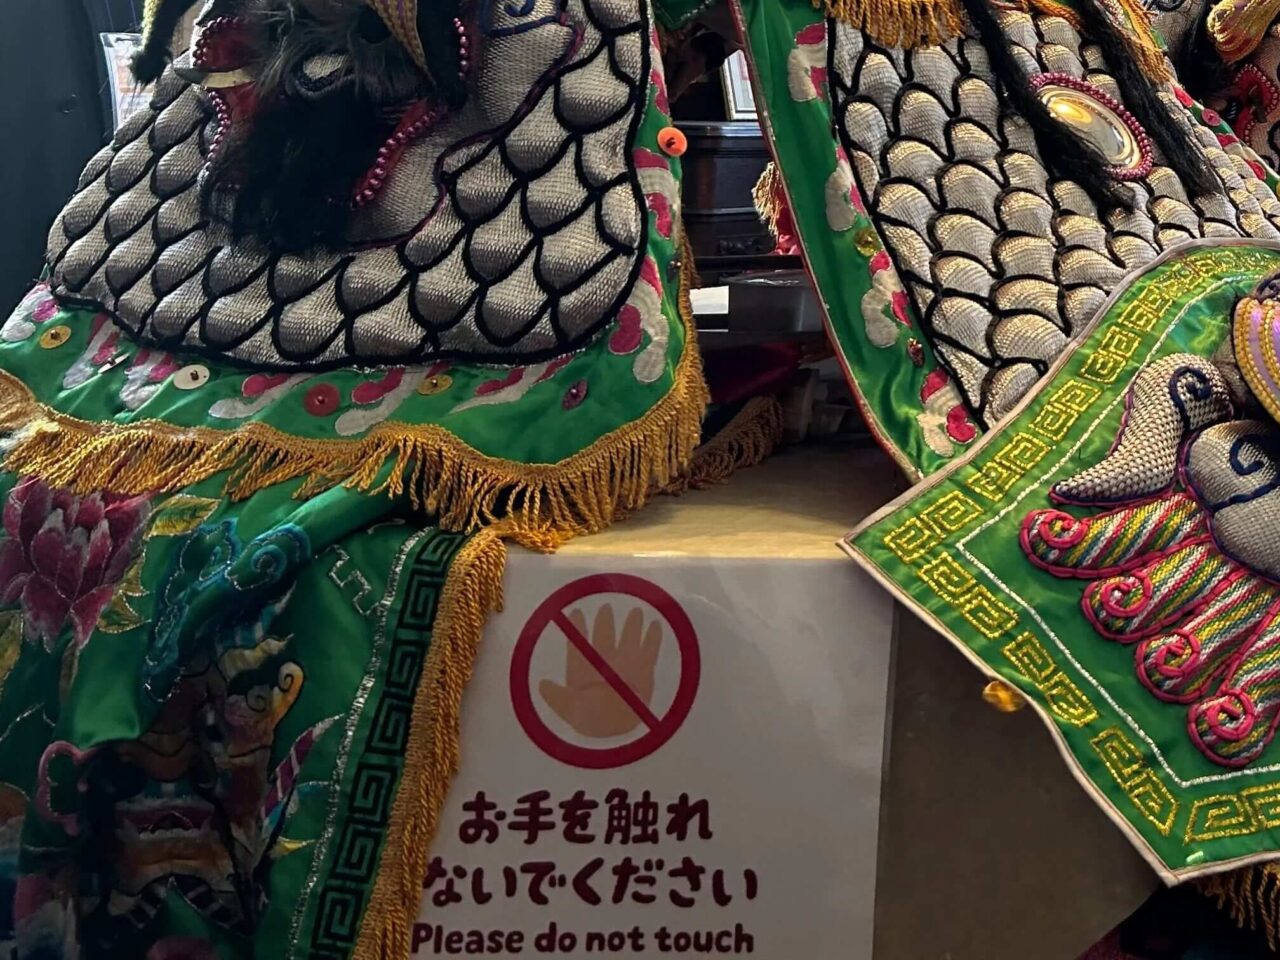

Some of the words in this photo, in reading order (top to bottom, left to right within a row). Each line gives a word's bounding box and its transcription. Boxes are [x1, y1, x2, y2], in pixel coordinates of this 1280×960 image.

[459, 788, 713, 844] お手を触れ
[422, 856, 758, 908] ないでください
[411, 922, 524, 954] Please
[534, 921, 577, 953] do
[585, 926, 645, 952] not
[654, 923, 754, 953] touch
